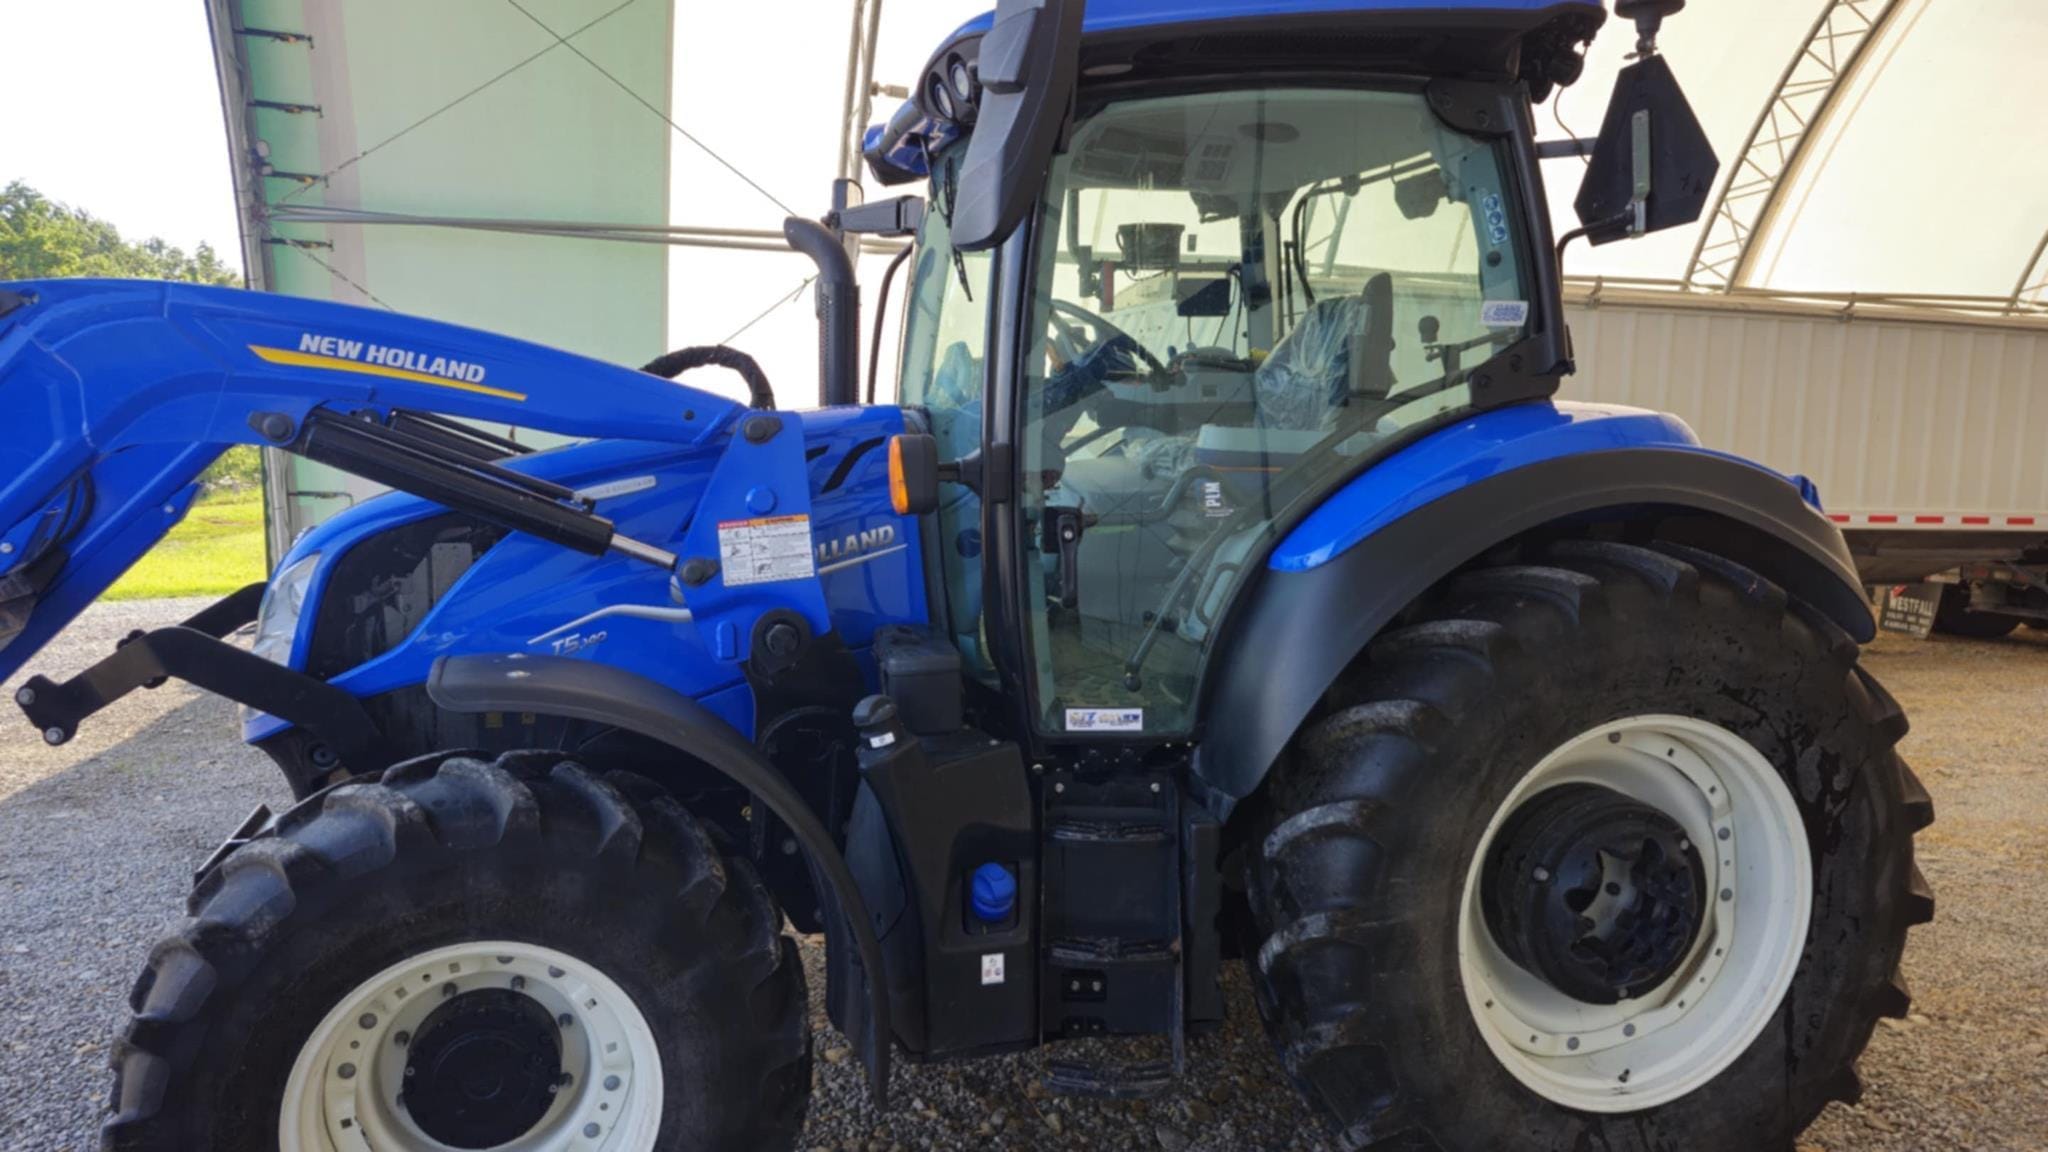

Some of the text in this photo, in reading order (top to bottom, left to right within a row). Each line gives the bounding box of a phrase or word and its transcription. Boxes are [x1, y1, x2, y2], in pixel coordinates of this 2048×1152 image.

[300, 333, 485, 384] NEW HOLLAND
[1205, 482, 1221, 507] PLM
[816, 525, 894, 563] LLAND
[1889, 597, 1935, 617] WESTFALL
